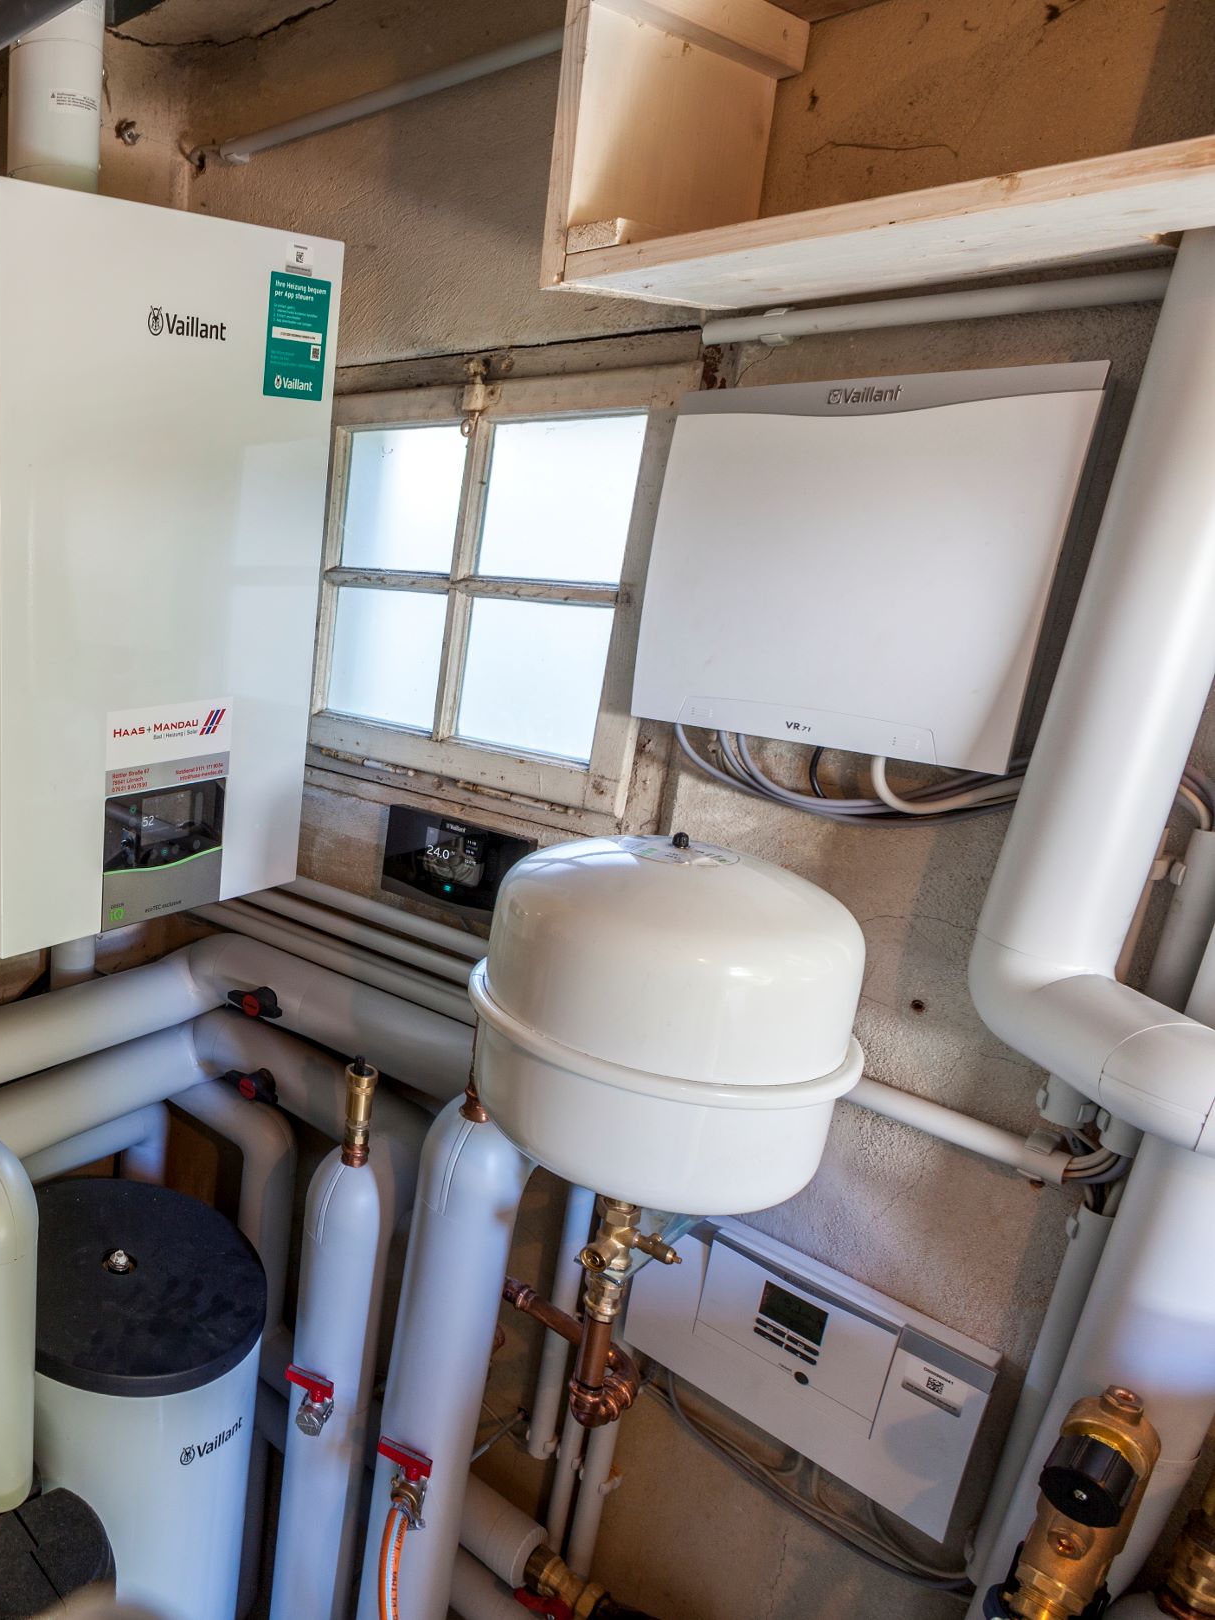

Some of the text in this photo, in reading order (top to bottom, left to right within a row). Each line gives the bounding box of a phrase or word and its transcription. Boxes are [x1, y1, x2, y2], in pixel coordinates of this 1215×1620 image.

[275, 279, 327, 295] Ihre Heizung bequem
[284, 291, 295, 300] App
[295, 293, 314, 302] steuern
[166, 312, 227, 341] Vaillant
[282, 377, 313, 392] Vaillant
[844, 384, 904, 404] Vaillant
[113, 726, 145, 738] HAAS
[153, 719, 199, 733] MANDAU
[785, 721, 800, 731] VR
[142, 815, 155, 827] 52
[426, 844, 450, 860] 24.0
[197, 1416, 243, 1457] Vaillant
